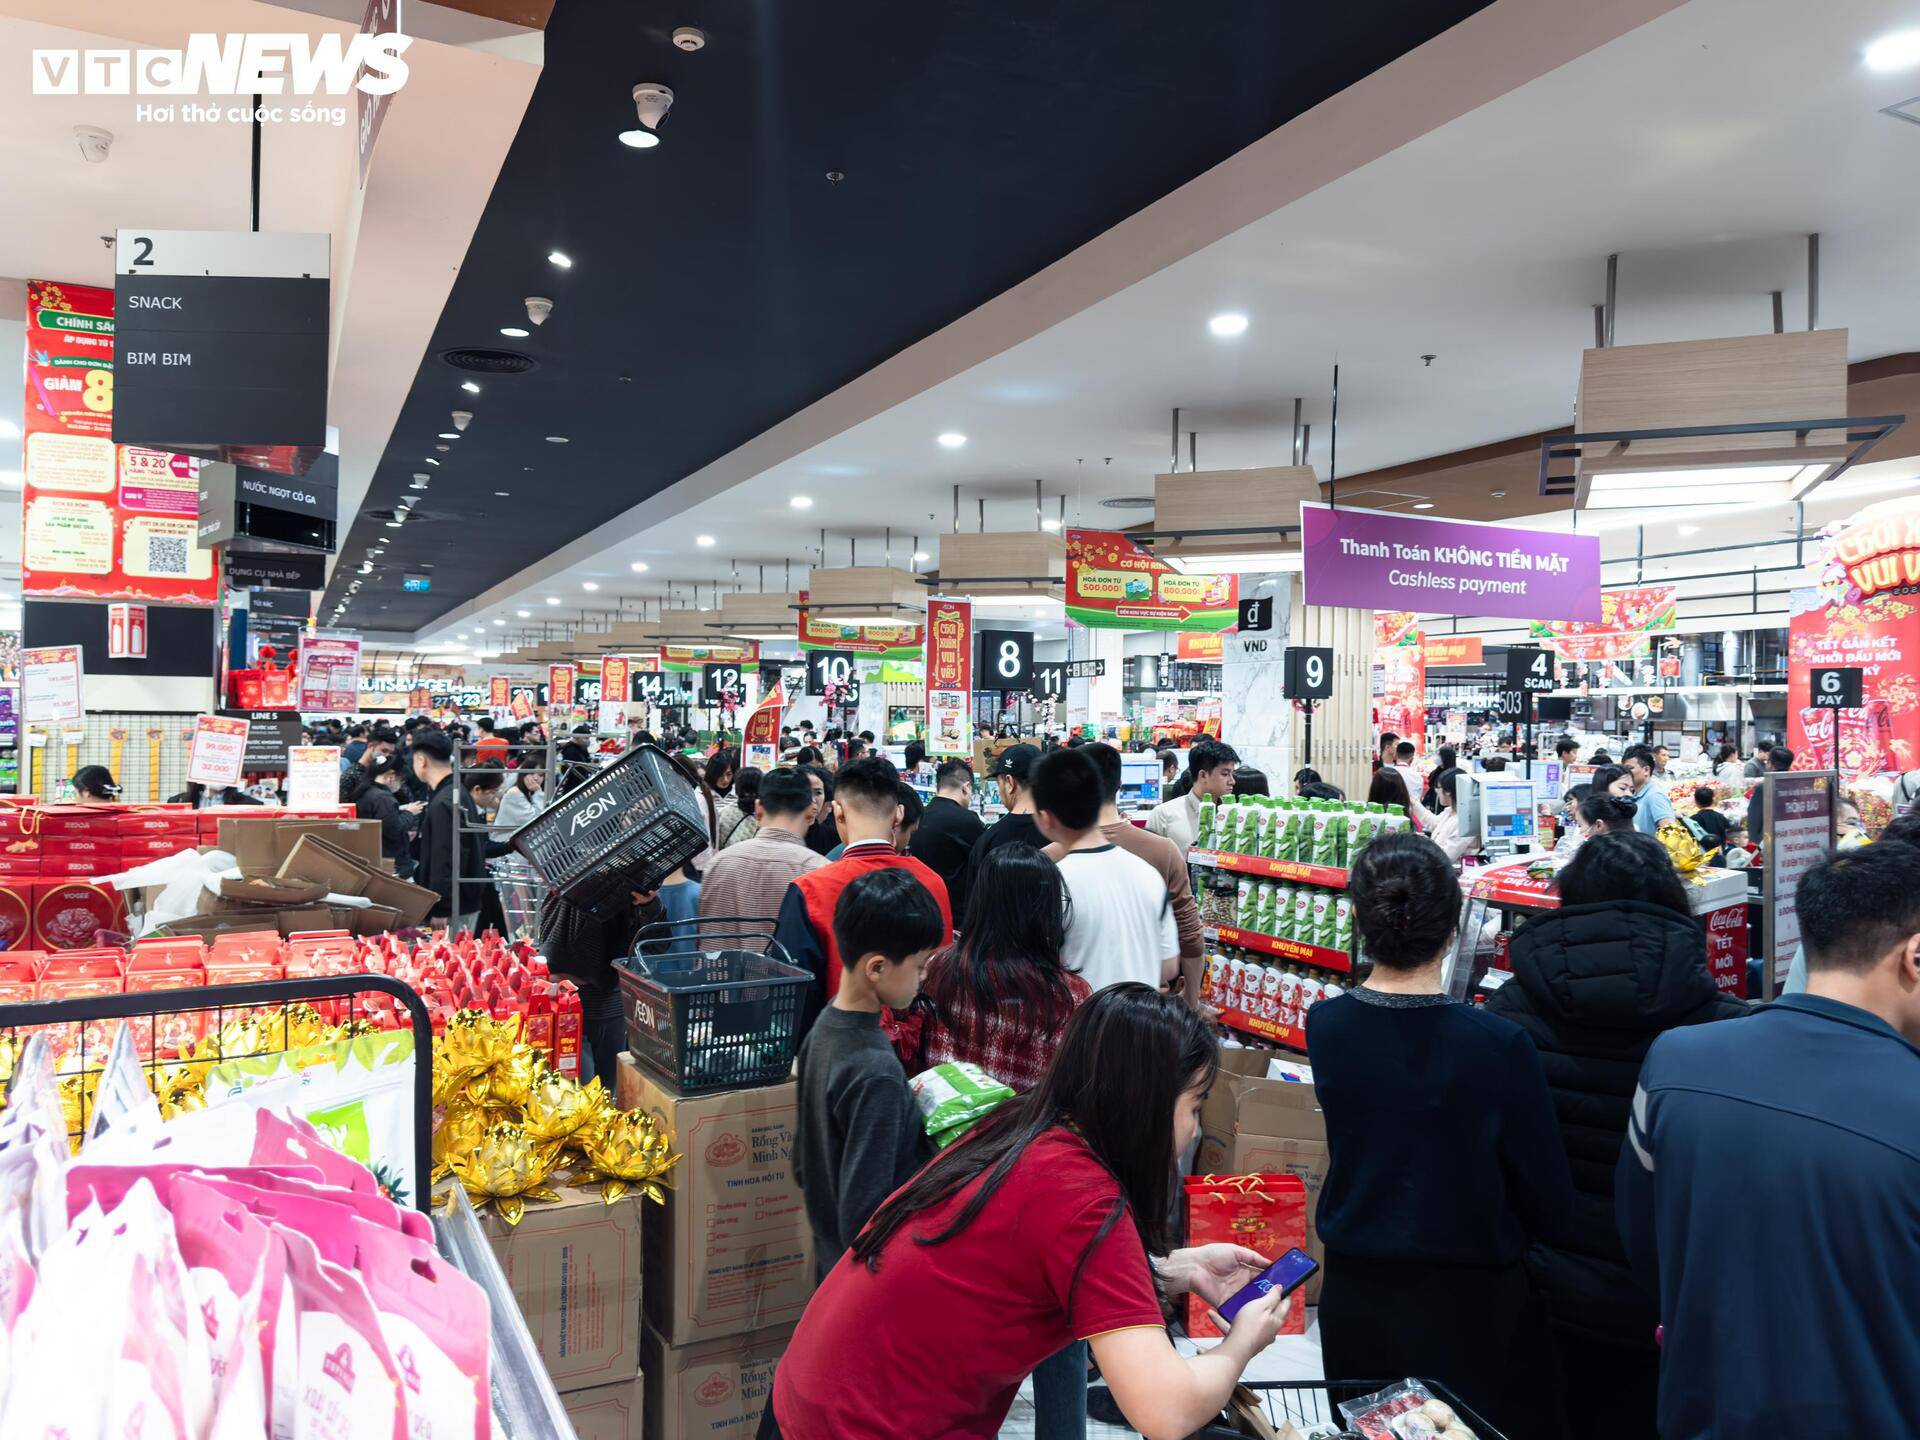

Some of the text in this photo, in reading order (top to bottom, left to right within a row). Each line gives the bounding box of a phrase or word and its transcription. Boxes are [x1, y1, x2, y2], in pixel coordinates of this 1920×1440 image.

[133, 237, 155, 266] 2
[129, 296, 182, 310] SNACK
[56, 316, 94, 330] CHÍNH
[127, 353, 192, 366] BIM BIM
[44, 375, 82, 391] GIẢM
[130, 456, 166, 469] 5 & 20
[243, 480, 317, 505] NƯỚC NGỌT CÓ GA
[1340, 538, 1569, 576] Thanh Toán KHÔNG TIỀN MẶT
[1098, 576, 1113, 584] ĐƠN
[1177, 579, 1191, 587] ĐƠN
[1388, 569, 1527, 597] Cashless payment
[1244, 640, 1268, 653] VND
[1816, 635, 1897, 650] TẾT GẮN KẾT
[941, 652, 955, 662] VUI
[999, 640, 1021, 677] 8
[1812, 649, 1901, 663] KHỞI ĐẦU MỚI
[817, 656, 850, 686] 10
[1306, 655, 1324, 688] 9
[1531, 653, 1547, 676] 4
[638, 675, 661, 697] 14
[711, 669, 738, 692] 12
[1040, 668, 1061, 694] 11
[1524, 677, 1552, 689] SCAN
[1821, 671, 1841, 693] 6
[580, 682, 601, 700] 16
[463, 694, 480, 706] 23
[1500, 691, 1521, 714] 503
[1817, 695, 1844, 705] PAY
[251, 712, 277, 720] LINE 5
[1269, 861, 1311, 878] KHUYẾN MẠI
[1271, 939, 1313, 958] KHUYẾN MẠI
[1715, 933, 1733, 950] TẾT
[1715, 953, 1734, 969] MỚI
[1248, 1017, 1289, 1038] KHUYẾN MẠI
[752, 1148, 778, 1164] Minh
[745, 1177, 761, 1186] HOA
[762, 1174, 775, 1183] HỘI
